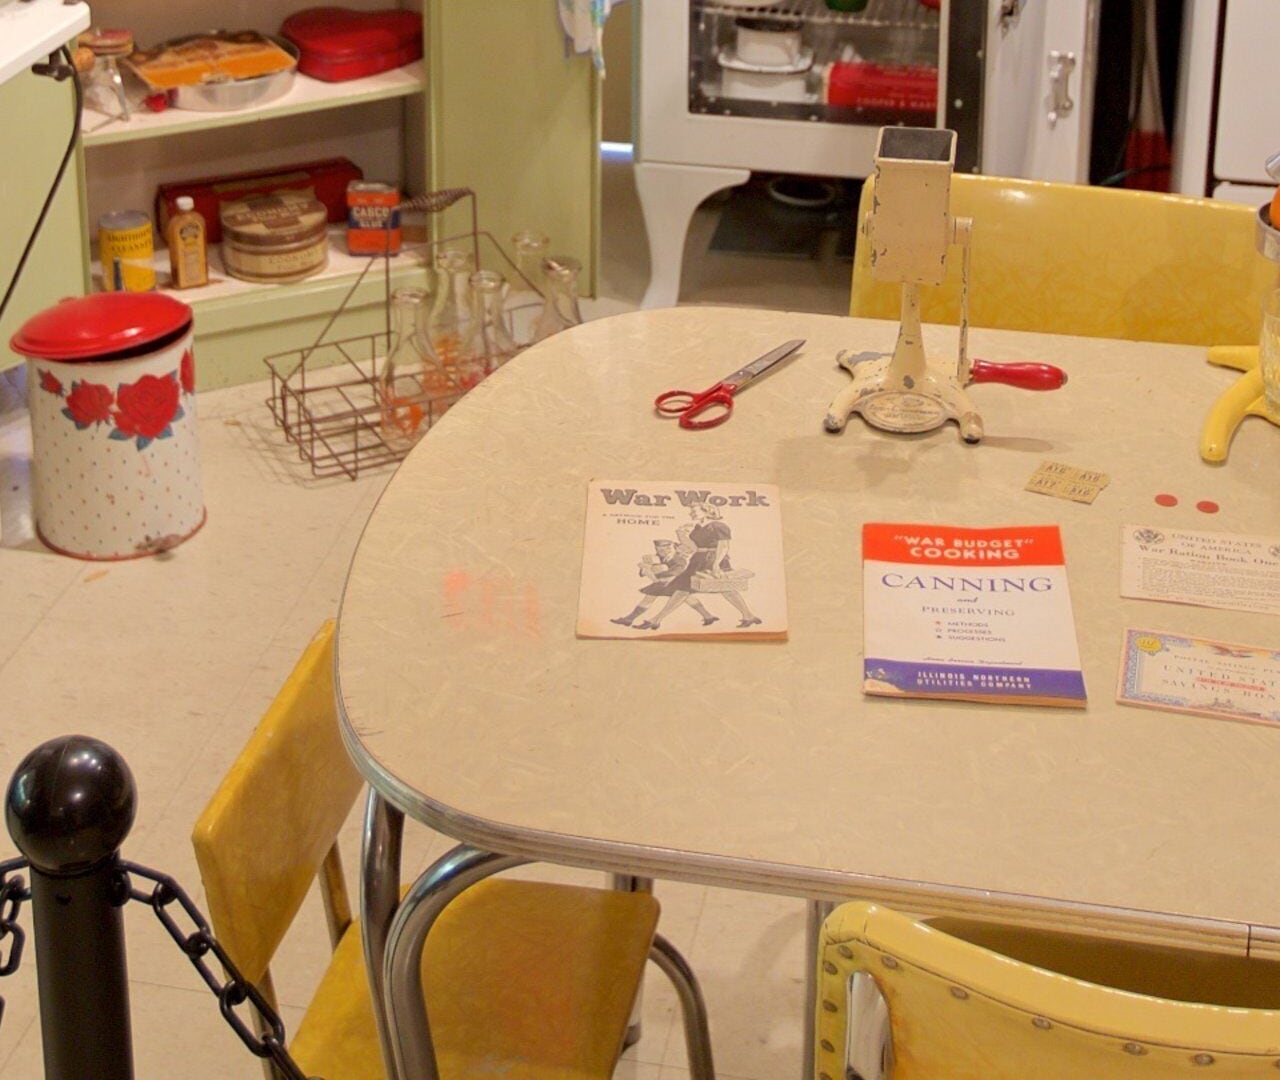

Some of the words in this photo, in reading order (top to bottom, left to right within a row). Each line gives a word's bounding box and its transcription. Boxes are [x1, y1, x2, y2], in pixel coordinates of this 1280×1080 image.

[600, 488, 671, 507] War
[674, 490, 770, 508] Work
[616, 518, 661, 527] HOME
[1171, 533, 1218, 546] UNITED
[910, 548, 1021, 560] COOKING
[1138, 544, 1166, 555] War
[1169, 548, 1212, 561] Ration
[881, 573, 1053, 593] CANNING
[922, 606, 1016, 617] PRESERVING
[947, 621, 990, 629] METHODS
[918, 671, 966, 681] ILLINOIS
[1163, 664, 1231, 680] UNITED
[917, 679, 972, 688] UTILITIES
[981, 681, 1033, 690] COMPANY
[1161, 678, 1231, 695] SAVINGS
